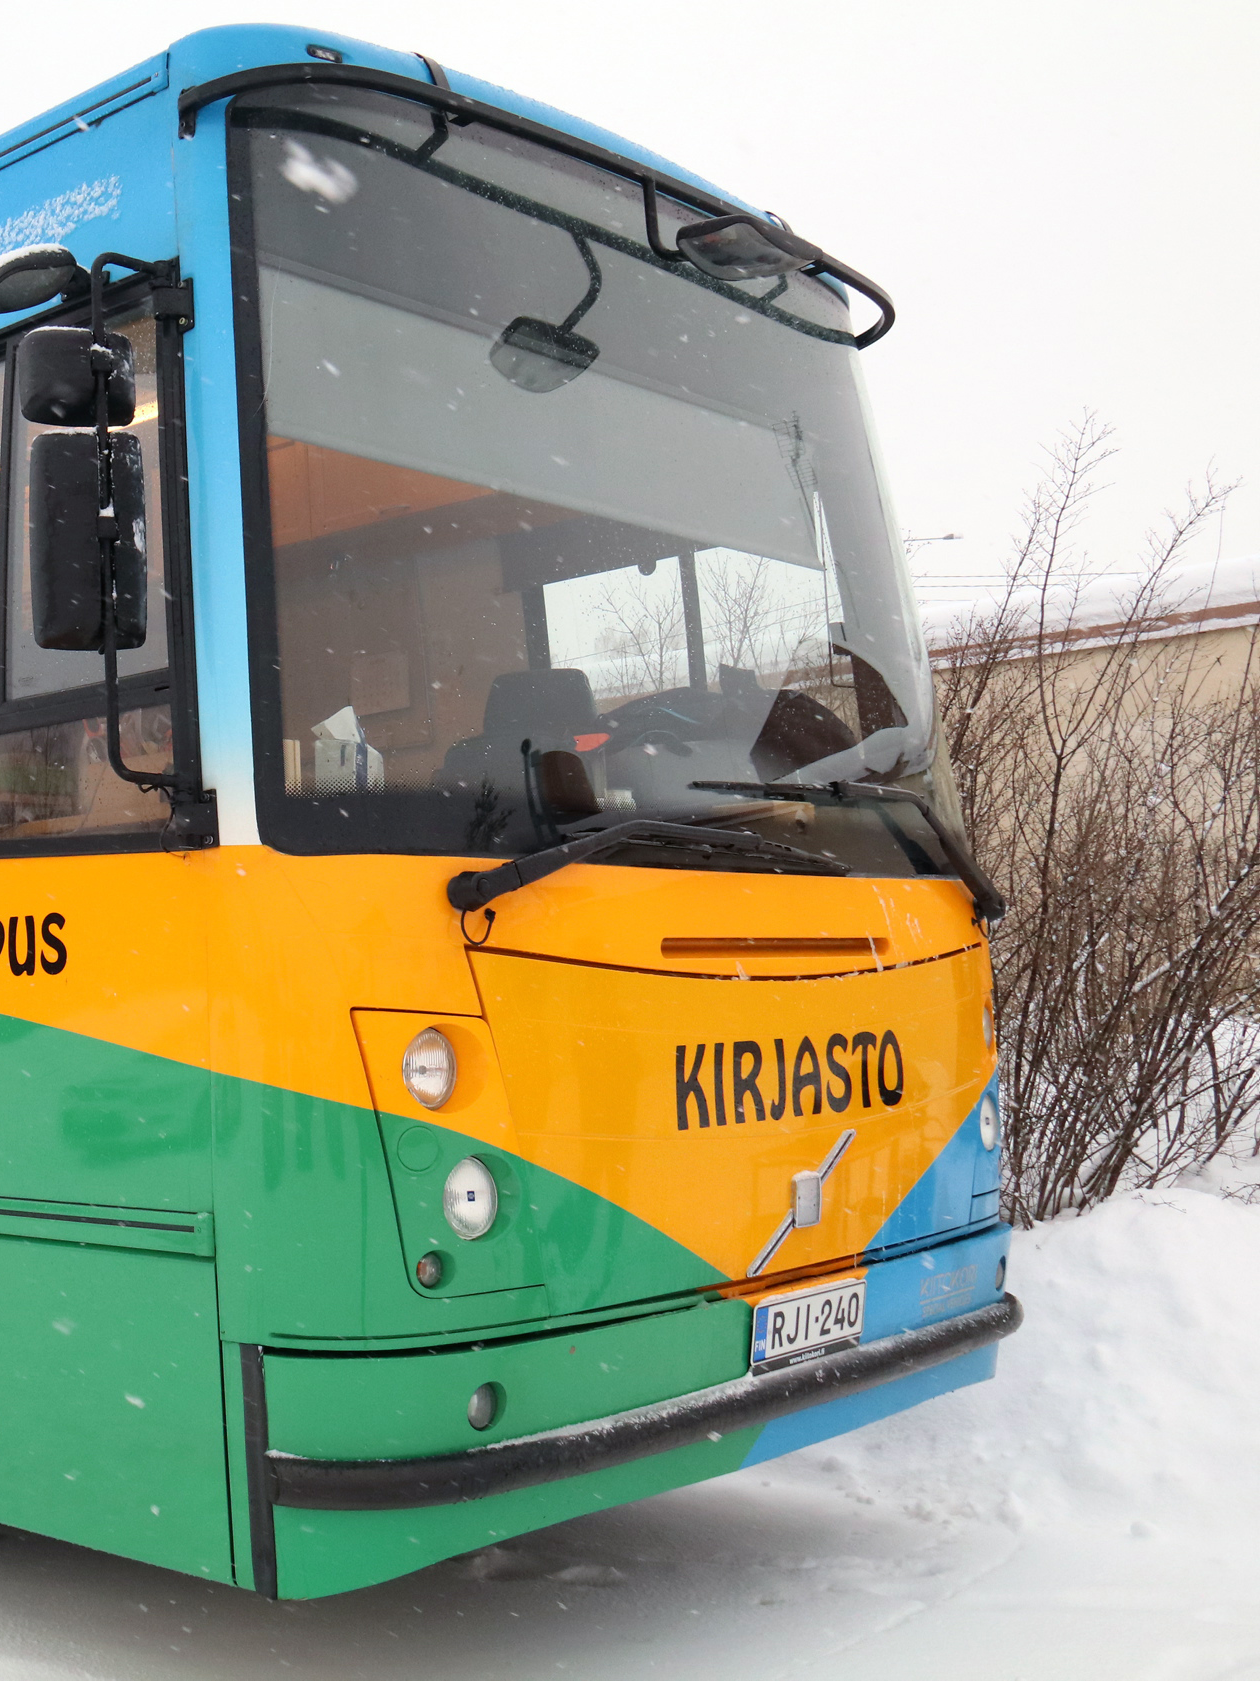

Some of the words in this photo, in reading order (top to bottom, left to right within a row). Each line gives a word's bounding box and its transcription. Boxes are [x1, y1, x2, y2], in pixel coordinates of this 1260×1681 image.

[675, 1029, 904, 1131] KIRJASTO
[754, 1339, 766, 1353] FIN
[771, 1292, 860, 1350] RJI-240
